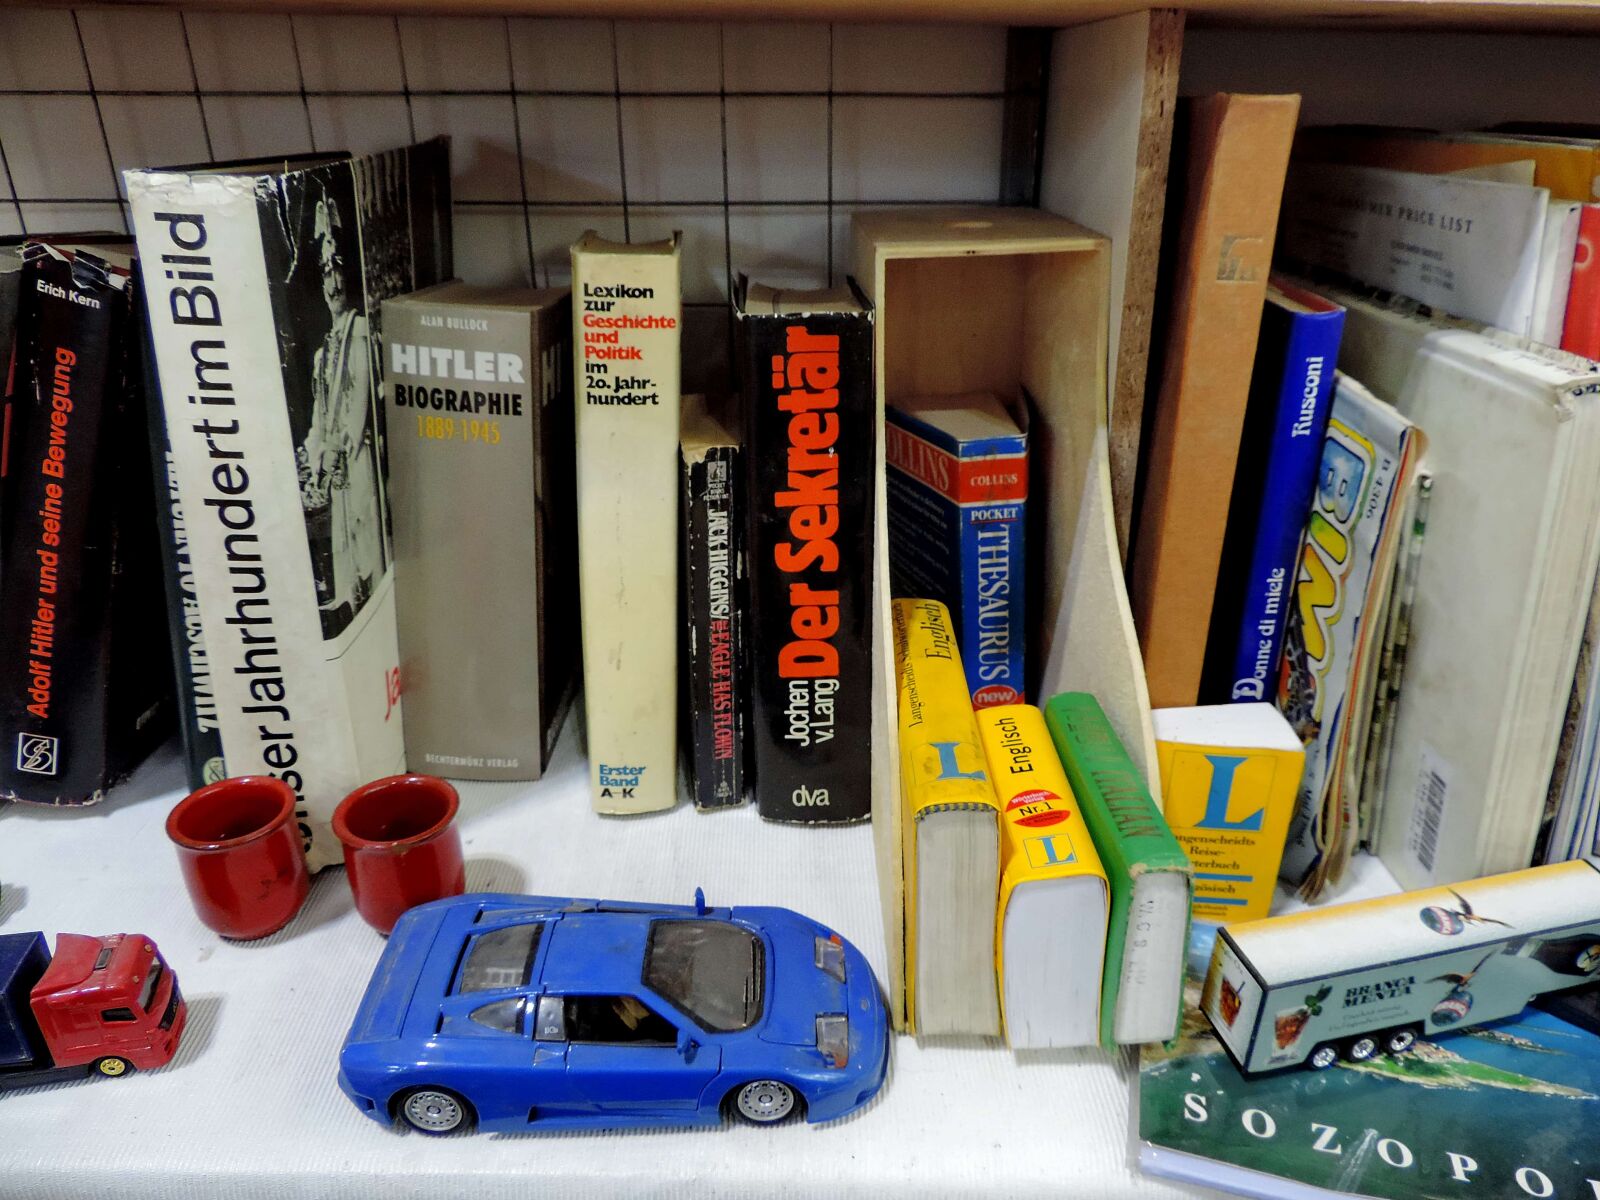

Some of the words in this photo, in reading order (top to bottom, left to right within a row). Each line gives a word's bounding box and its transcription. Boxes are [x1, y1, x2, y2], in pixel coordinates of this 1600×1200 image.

[1440, 215, 1474, 235] LIST
[153, 211, 223, 327] Bild
[36, 278, 67, 300] Erich
[68, 289, 101, 310] Kern
[583, 282, 654, 299] Lexikon
[583, 299, 616, 312] zur
[420, 315, 444, 328] ALAN
[447, 317, 489, 331] BULLOCK
[583, 313, 677, 329] Geschichte
[584, 330, 619, 344] und
[391, 342, 526, 384] HITLER
[584, 345, 643, 360] Politik
[585, 360, 608, 374] im
[187, 340, 236, 406] im
[585, 375, 611, 389] 20.
[613, 375, 657, 393] Jahr-
[42, 347, 77, 480] Bewegung
[394, 383, 523, 416] BIOGRAPHIE
[586, 391, 660, 406] hundert
[1292, 356, 1324, 438] Rusconi
[771, 325, 840, 573] Sekretär
[970, 473, 1018, 487] COLLINS
[38, 483, 64, 547] seine
[708, 508, 729, 550] JACK
[970, 507, 1018, 521] POCKET
[36, 551, 59, 594] und
[193, 418, 290, 721] Jahrhundert
[977, 523, 1010, 682] THESAURUS
[1264, 567, 1286, 616] miele
[30, 596, 56, 659] Hitler
[777, 582, 840, 679] Der
[916, 603, 956, 661] Englisch
[1258, 619, 1276, 638] di
[711, 632, 732, 679] EAGLE
[1232, 639, 1273, 702] Donne
[26, 661, 53, 719] Adolf
[713, 680, 732, 712] HAS
[977, 690, 1013, 702] new
[783, 680, 810, 747] Jochen
[714, 713, 733, 761] FLOWN
[995, 717, 1035, 775] Englisch
[425, 753, 484, 768] BECHTERMÜNZ
[486, 756, 519, 769] VERLAG
[599, 764, 646, 776] Erster
[928, 741, 987, 781] L
[599, 775, 639, 787] Band
[792, 785, 831, 807] dva
[1193, 755, 1265, 832] L
[1018, 805, 1044, 817] Nr.
[1044, 801, 1054, 810] 1
[1037, 834, 1076, 866] L
[1189, 846, 1226, 857] Reise-
